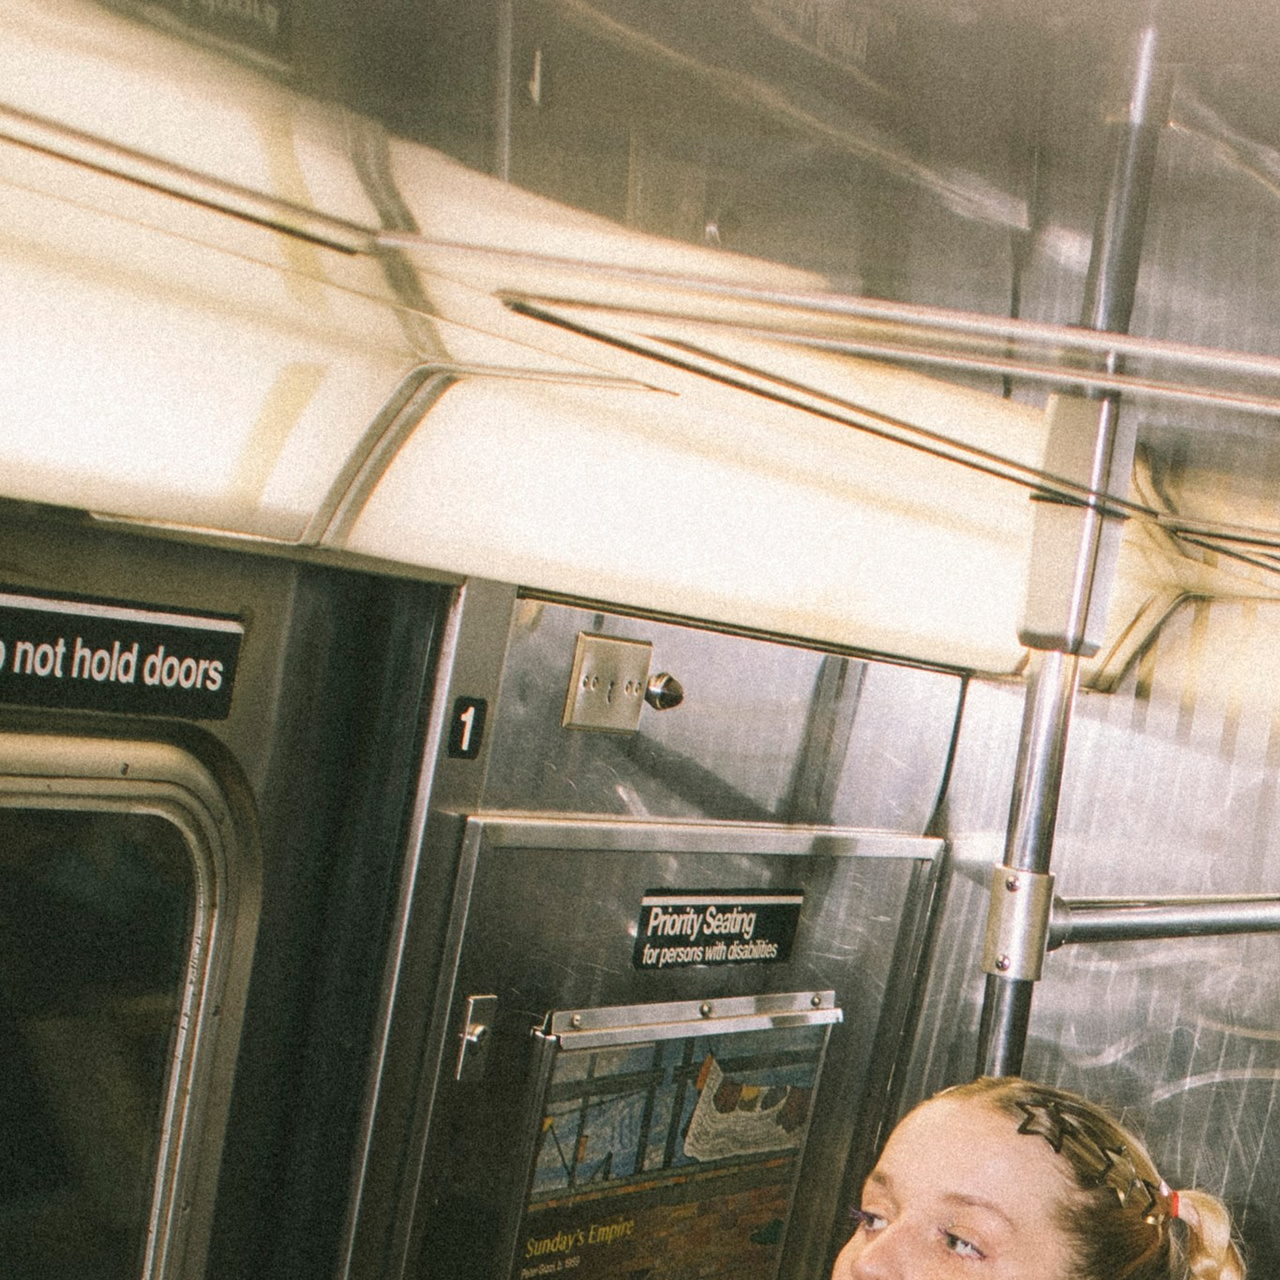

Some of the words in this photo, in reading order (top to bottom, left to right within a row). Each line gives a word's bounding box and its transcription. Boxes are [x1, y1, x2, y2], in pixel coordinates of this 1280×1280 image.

[13, 637, 66, 678] not
[72, 637, 139, 683] hold
[144, 645, 224, 691] doors
[460, 706, 475, 751] 1
[647, 906, 703, 941] Priority
[703, 906, 757, 939] Seating
[642, 943, 660, 964] for
[658, 945, 704, 968] persons
[705, 941, 727, 960] with
[728, 939, 778, 959] disabilities
[525, 1228, 585, 1258] Sunday's
[588, 1215, 635, 1244] Empire
